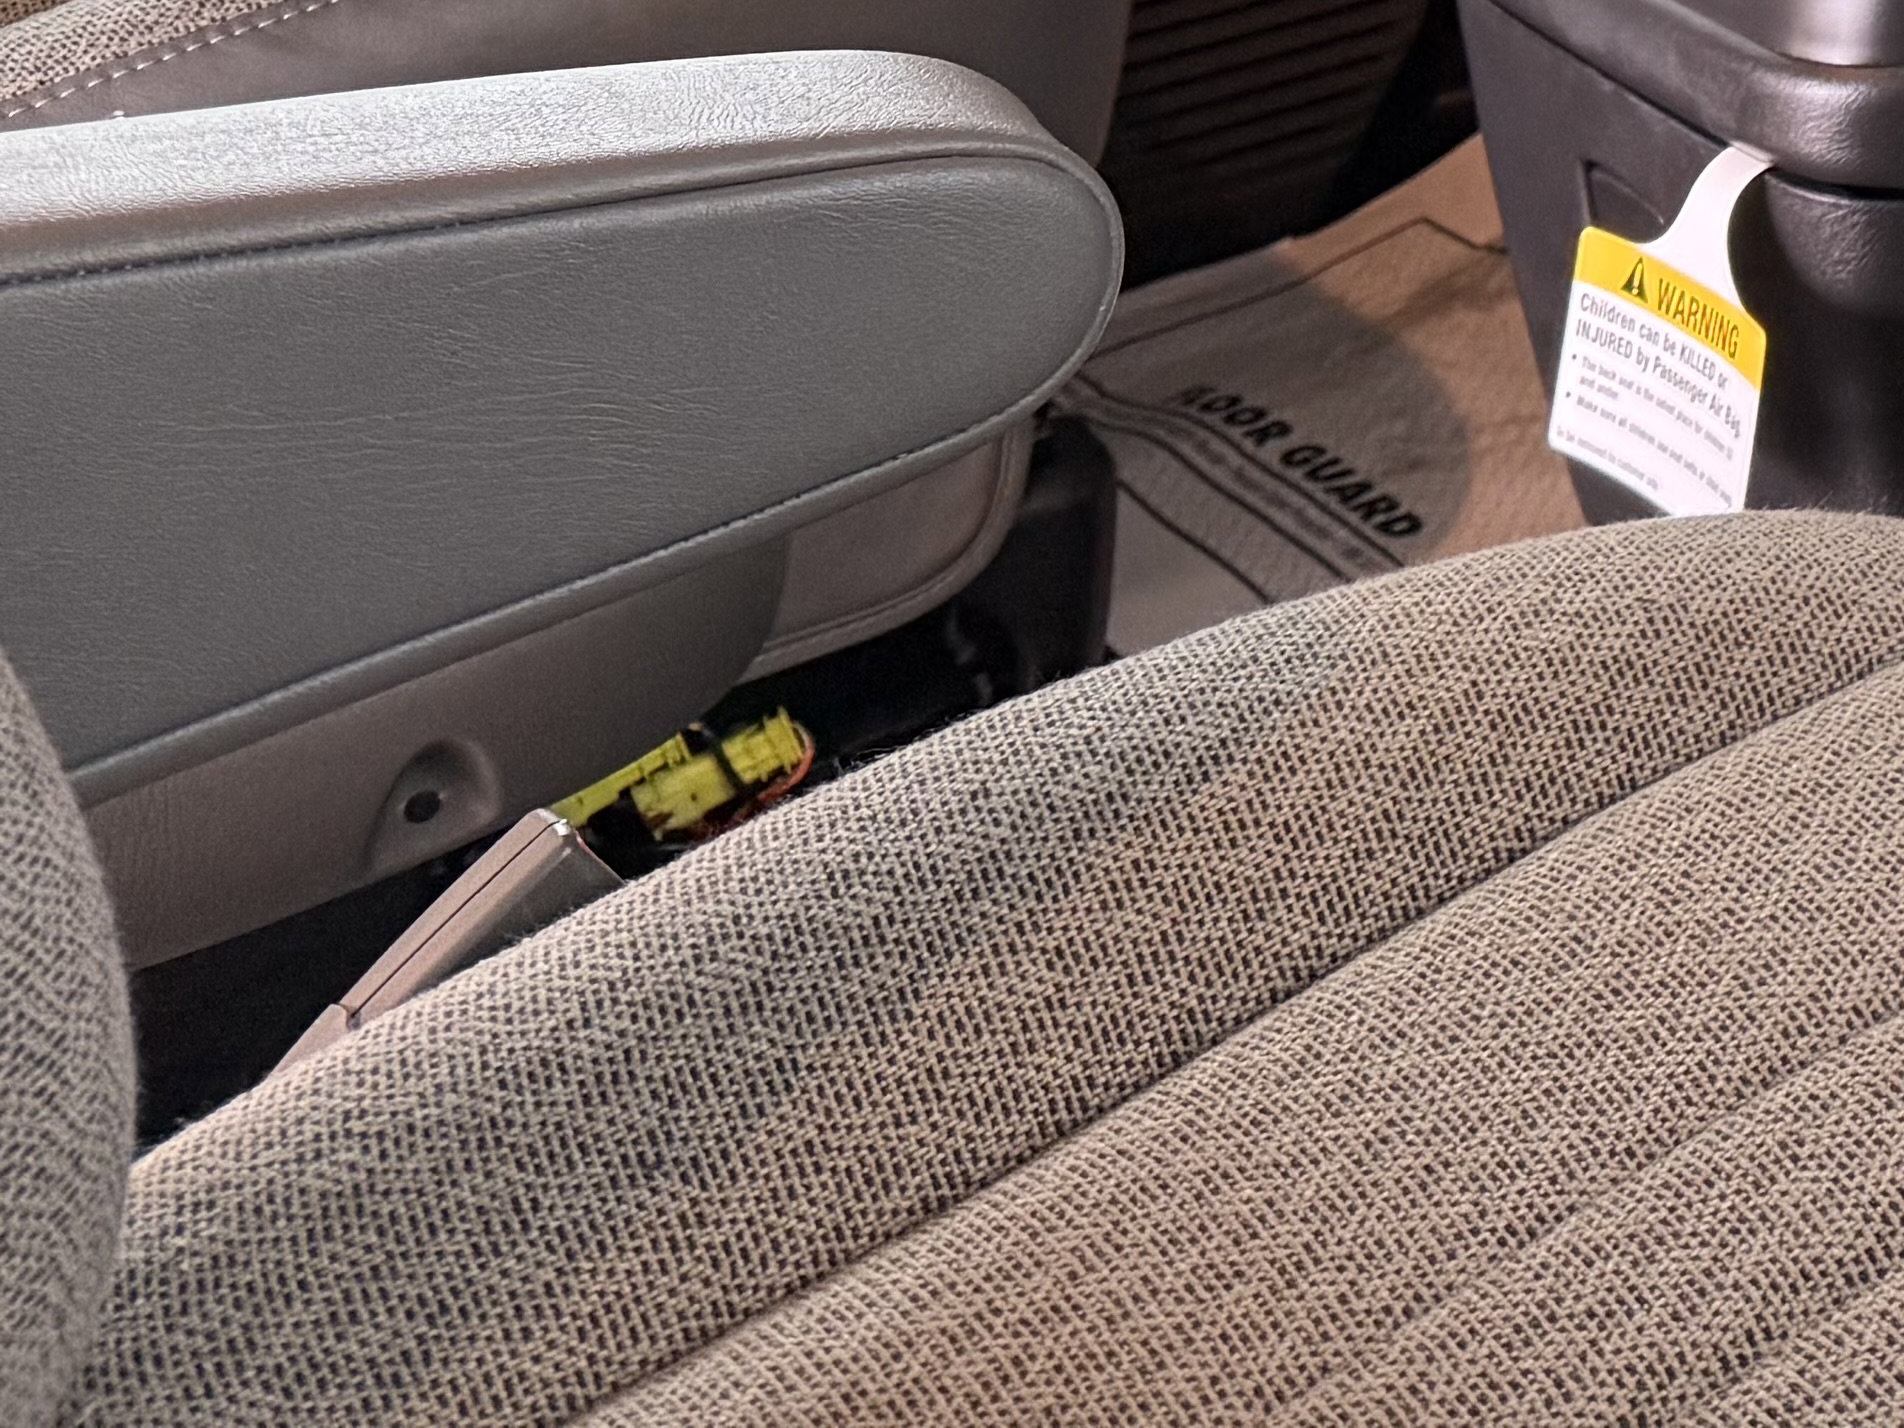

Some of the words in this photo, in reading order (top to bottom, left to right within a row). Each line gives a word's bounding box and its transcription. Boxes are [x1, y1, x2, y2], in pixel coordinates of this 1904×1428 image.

[1580, 292, 1636, 333] Children
[1639, 323, 1661, 347] can
[1663, 333, 1677, 357] be
[1679, 343, 1716, 381] KILLED
[1717, 372, 1729, 390] or
[1657, 277, 1740, 360] WARNING
[1576, 318, 1633, 360] INJURED
[1636, 346, 1651, 373] by
[1652, 355, 1708, 404] Passenger
[1708, 394, 1724, 418] Air
[1280, 445, 1424, 538] GUARD
